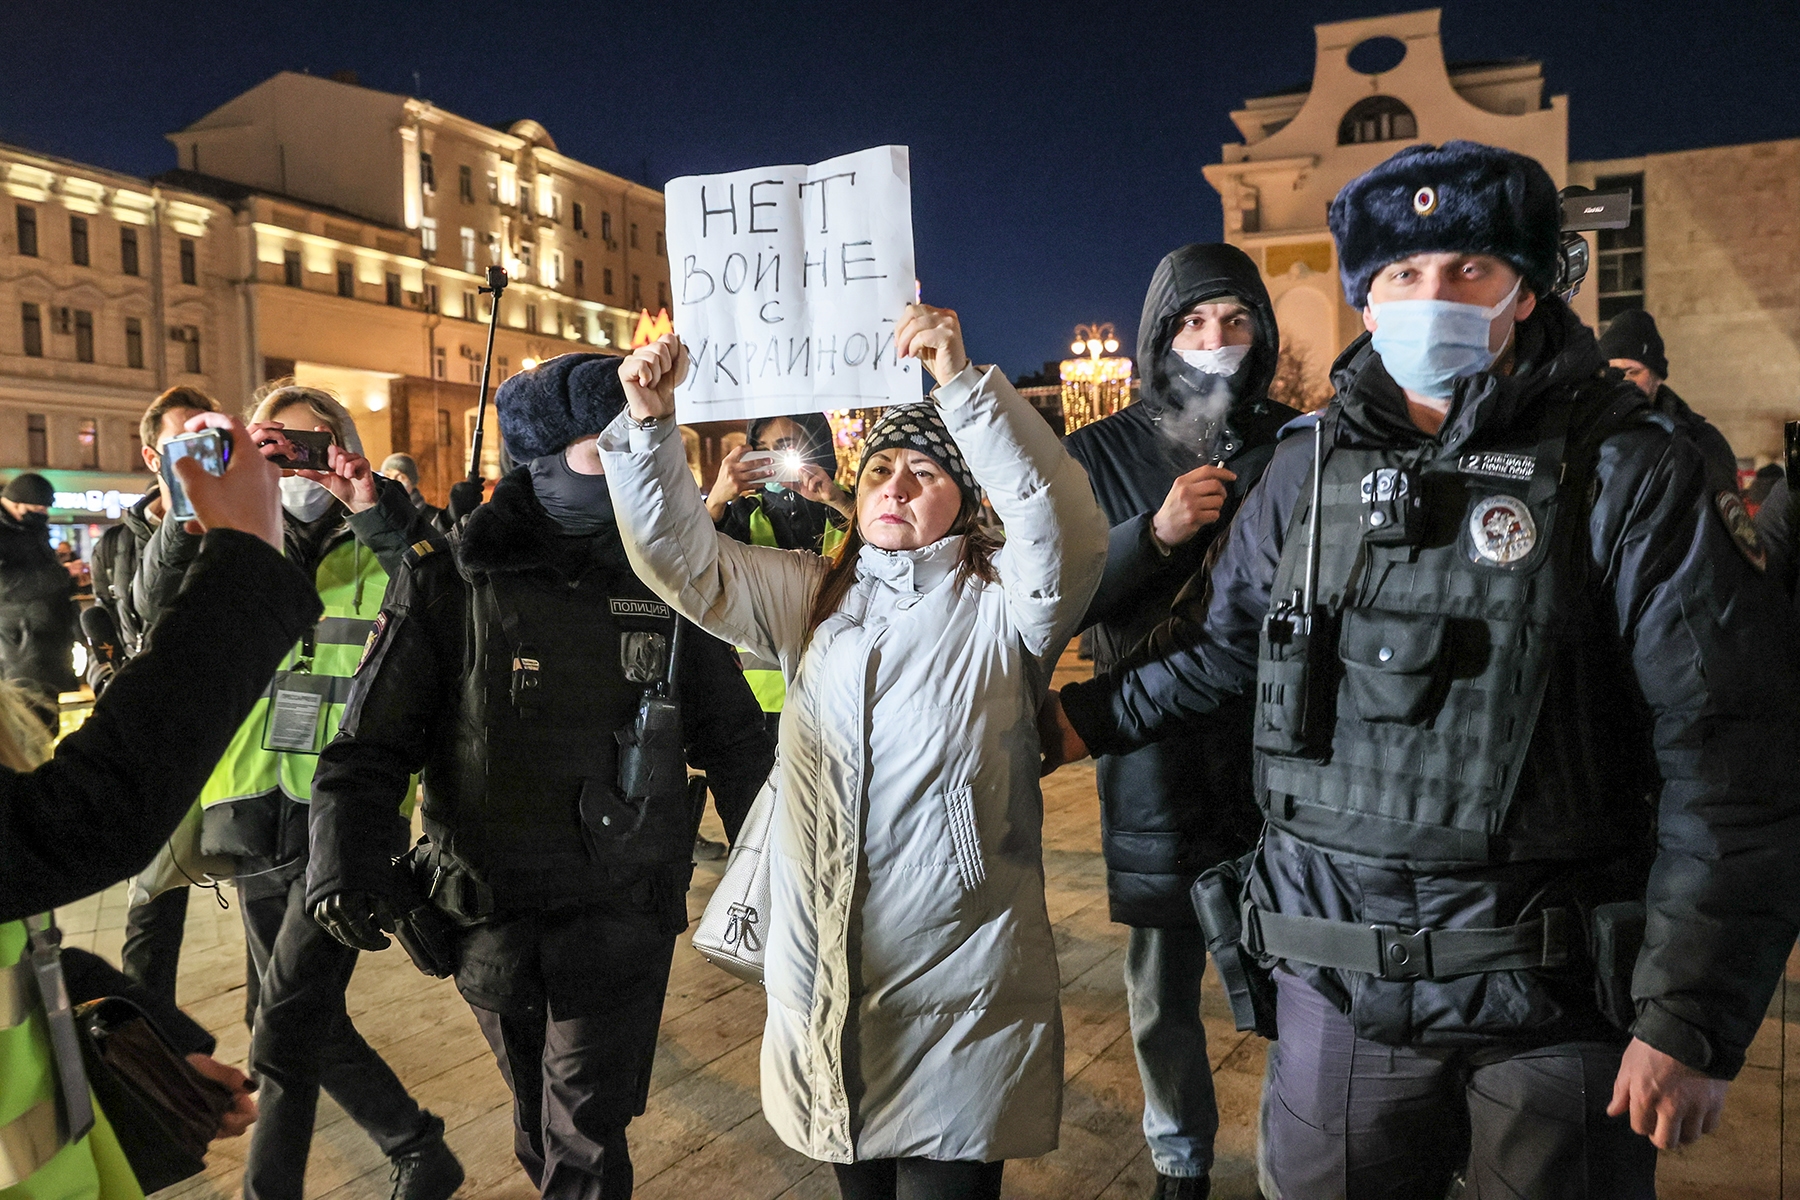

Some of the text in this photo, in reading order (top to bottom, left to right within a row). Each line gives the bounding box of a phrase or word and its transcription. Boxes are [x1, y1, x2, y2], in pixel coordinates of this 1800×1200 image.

[701, 171, 856, 238] НЕТ
[682, 240, 888, 305] ВОЙНЕ
[685, 303, 911, 391] УКРАИНОЙ
[613, 602, 667, 615] ПОЛИЦИЯ
